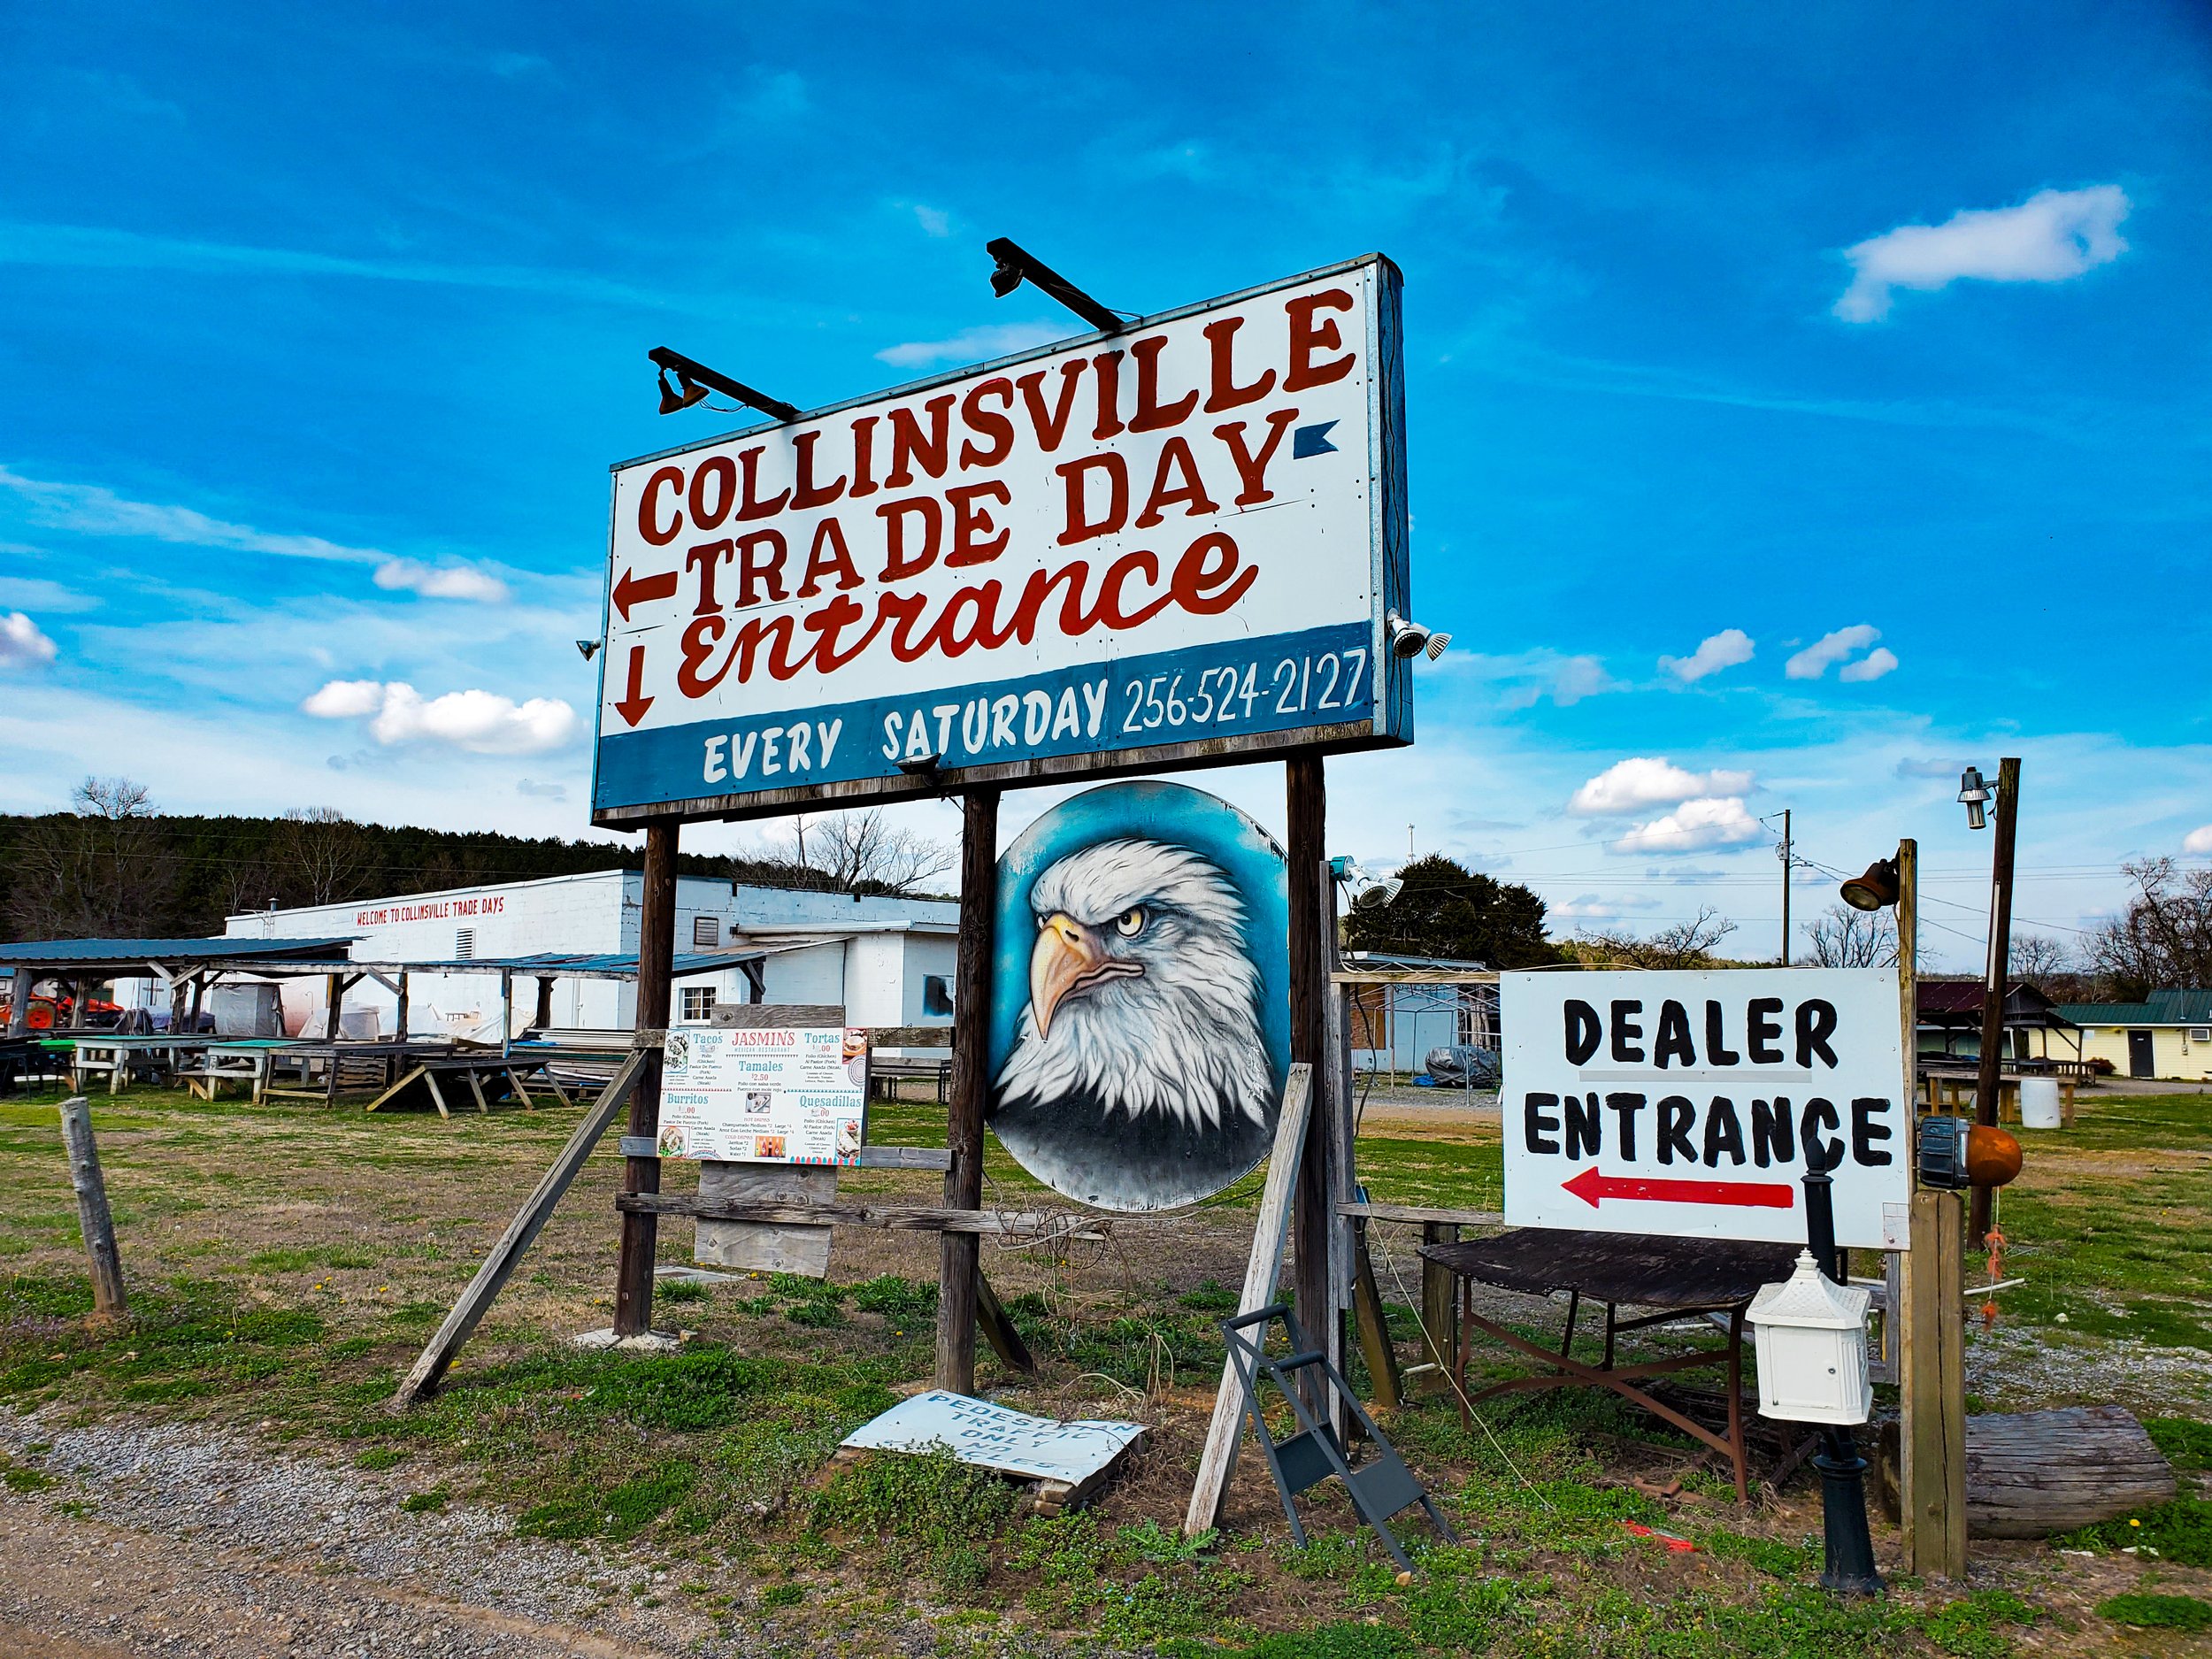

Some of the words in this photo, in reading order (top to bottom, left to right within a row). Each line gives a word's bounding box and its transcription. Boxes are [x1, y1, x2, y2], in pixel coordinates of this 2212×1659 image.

[639, 288, 1356, 546] COLLINSVILLE
[686, 480, 1011, 616] TRADE
[1056, 407, 1300, 546] DAY
[677, 531, 1259, 700] Entrance
[703, 718, 843, 784] EVERY
[882, 678, 1109, 761] SATURDAY
[1123, 648, 1367, 733] 256-524-2127
[357, 909, 388, 926] WELCOME
[390, 908, 399, 924] TO
[401, 902, 449, 922] COLLINSVILLE
[452, 899, 479, 918] TRADE
[481, 896, 505, 915] DAYS
[693, 1033, 723, 1044] Tacos
[804, 1033, 841, 1044] Tortas
[1563, 997, 1839, 1070] DEALER
[739, 1061, 783, 1071] Tamales
[667, 1093, 709, 1104] Burritos
[800, 1095, 862, 1108] Quesadillas
[1524, 1092, 1893, 1171] ENTRANCE
[951, 1411, 1093, 1440] TRAFFIC
[960, 1429, 1050, 1448] ONLY
[965, 1442, 1012, 1452] NO
